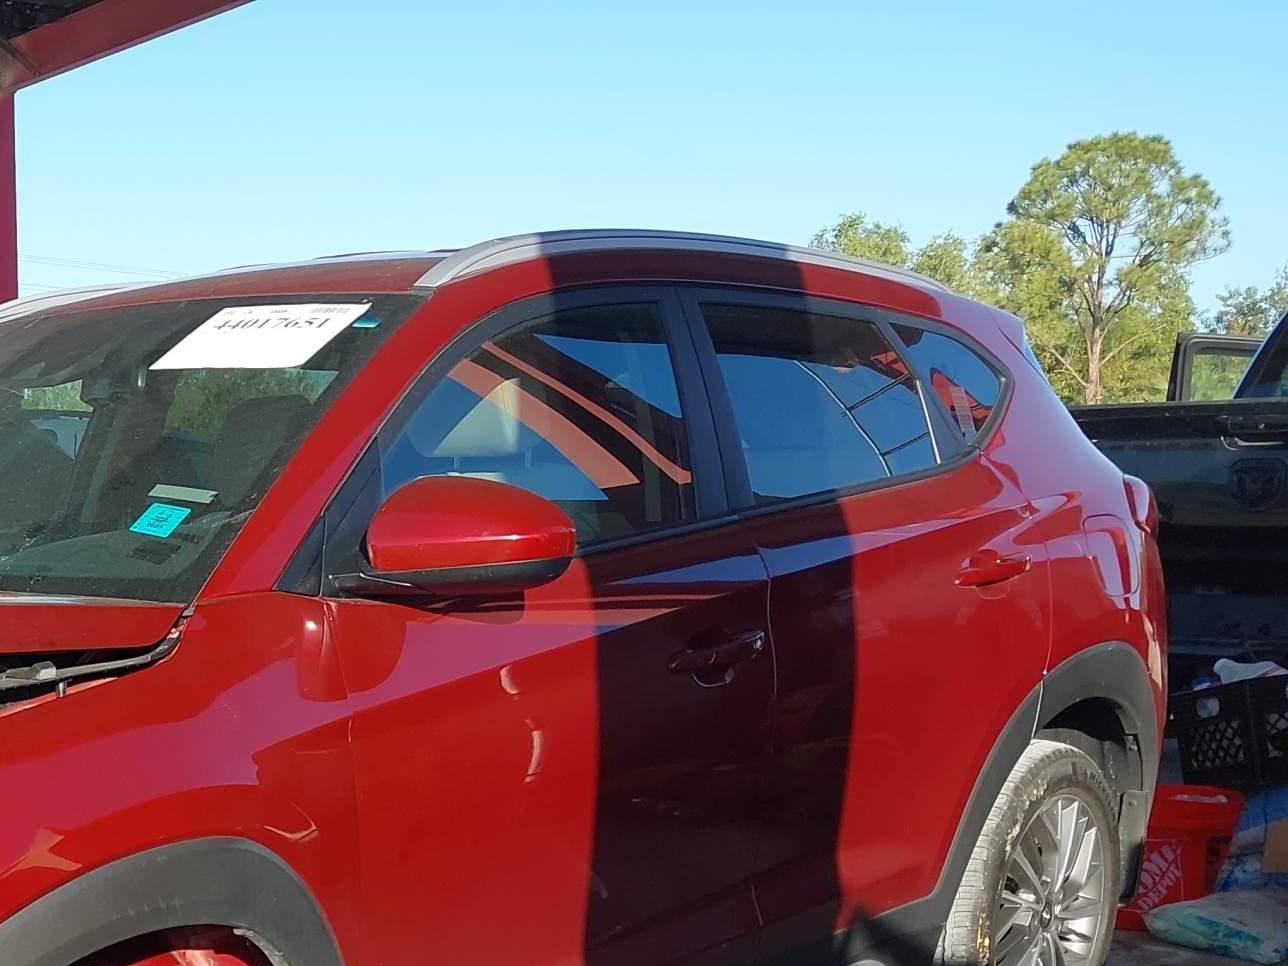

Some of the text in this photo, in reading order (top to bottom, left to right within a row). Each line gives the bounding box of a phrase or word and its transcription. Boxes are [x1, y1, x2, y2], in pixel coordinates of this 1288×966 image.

[214, 317, 332, 330] 44017651
[1136, 863, 1179, 912] DEPOT
[1138, 839, 1181, 894] OME
